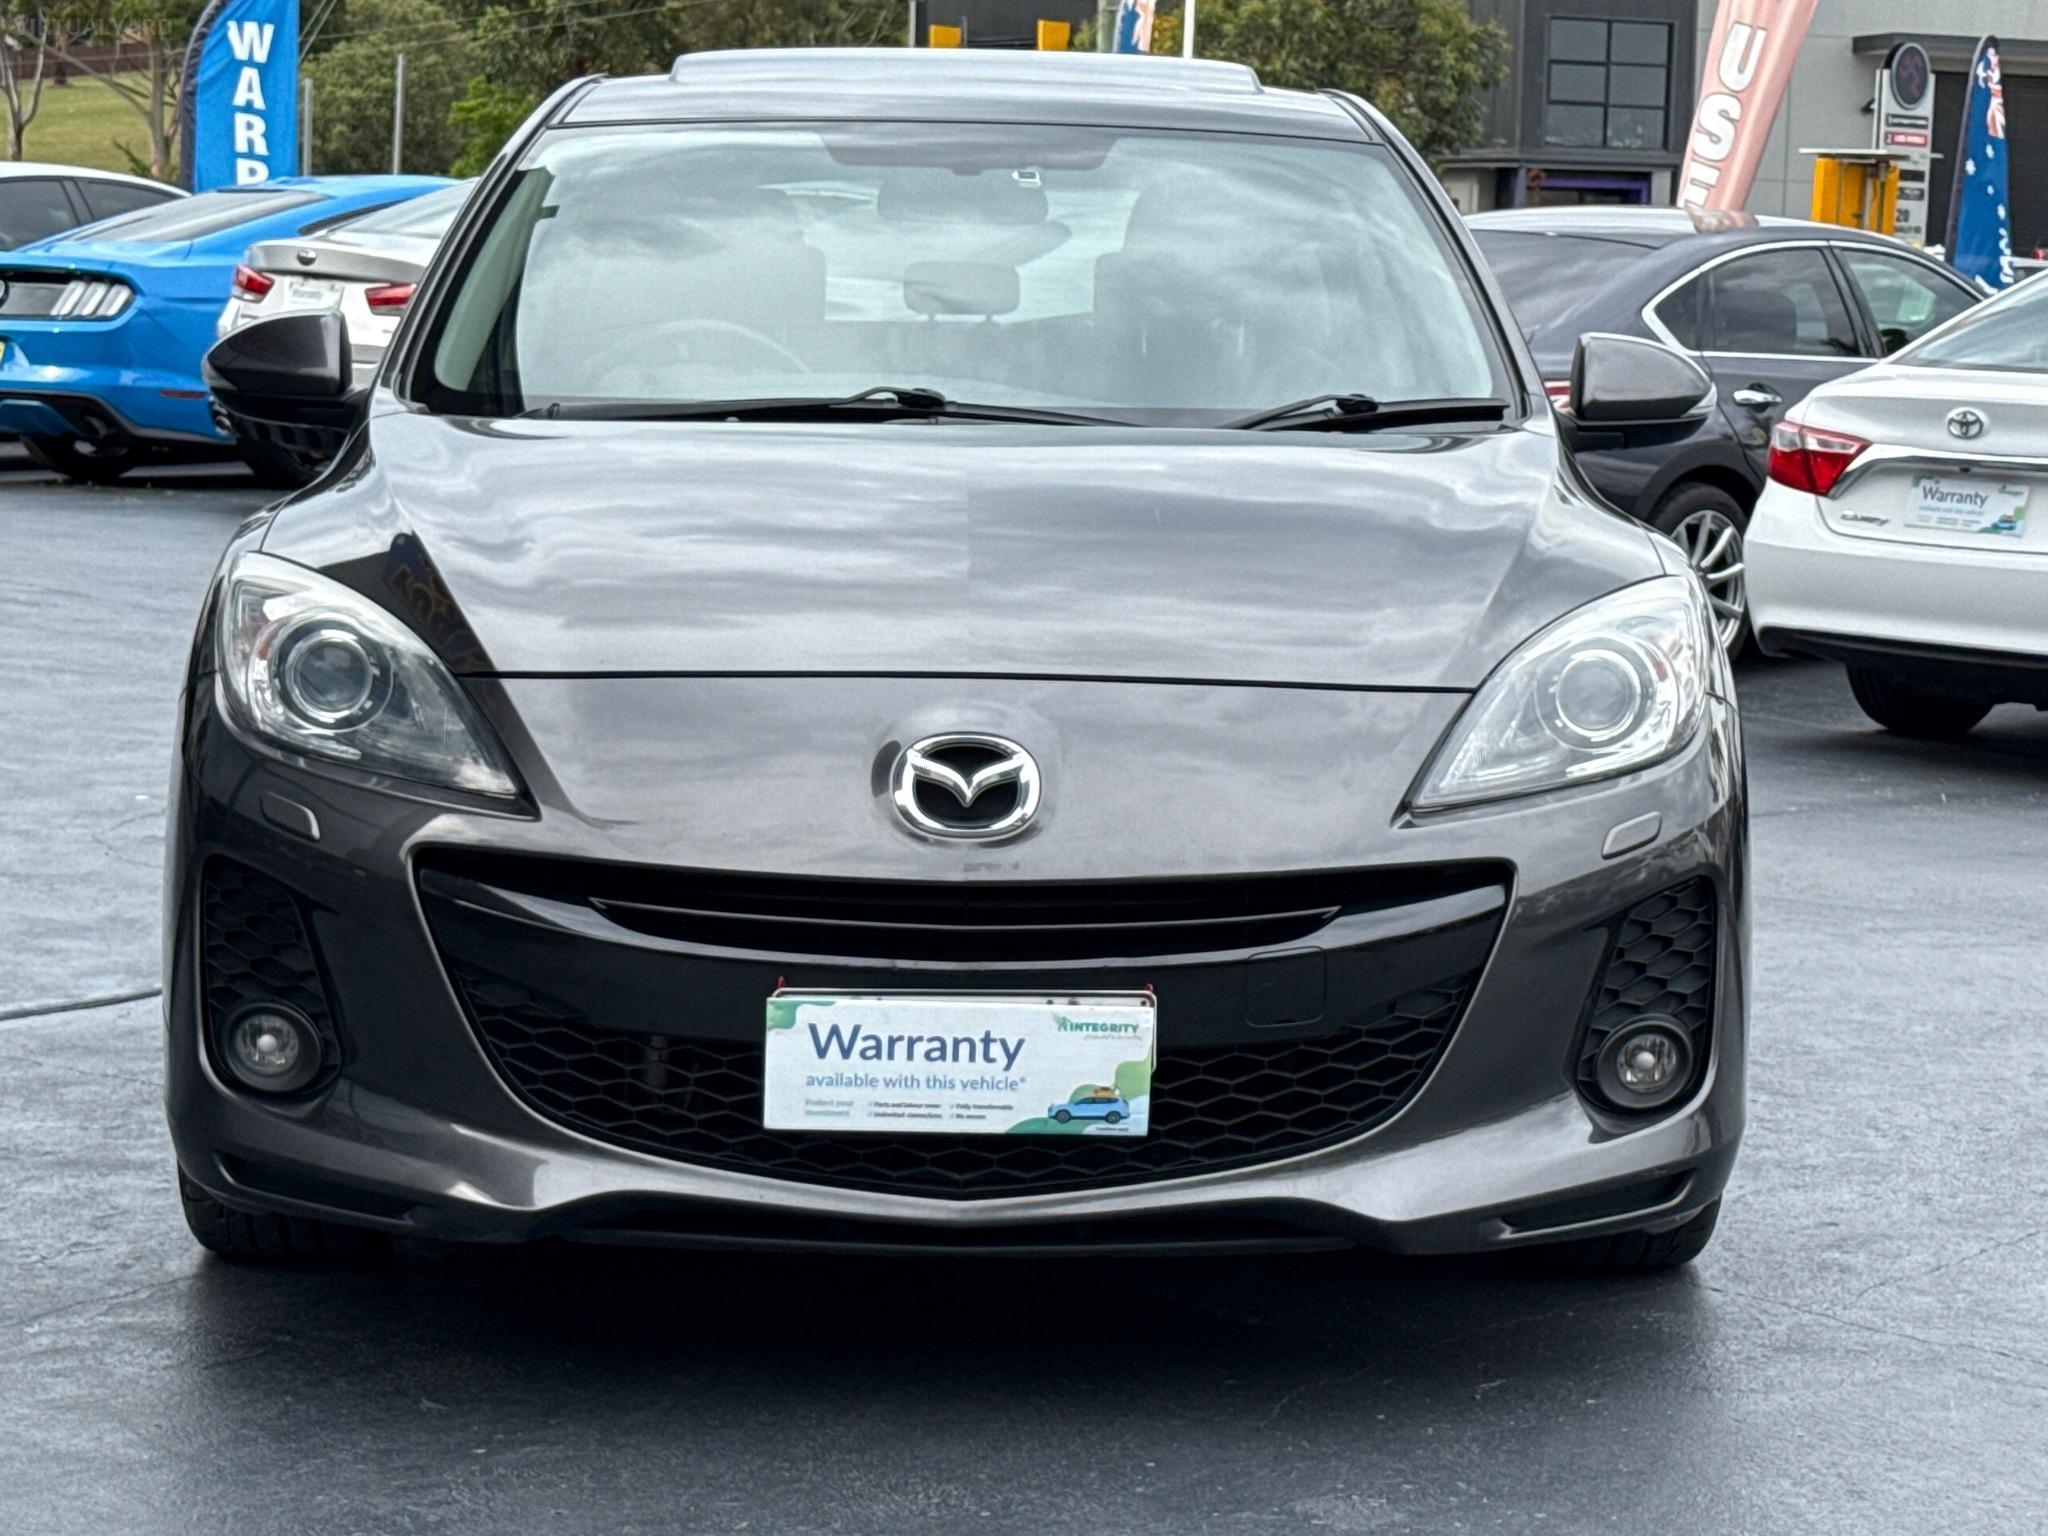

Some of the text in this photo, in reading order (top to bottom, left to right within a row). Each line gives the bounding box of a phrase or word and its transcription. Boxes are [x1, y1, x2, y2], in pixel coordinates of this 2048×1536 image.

[1922, 485, 1988, 509] Warranty
[1069, 1022, 1139, 1033] INTEGRITY
[808, 1022, 1026, 1072] Warranty
[806, 1073, 880, 1089] available
[883, 1074, 921, 1090] with
[925, 1075, 956, 1091] this
